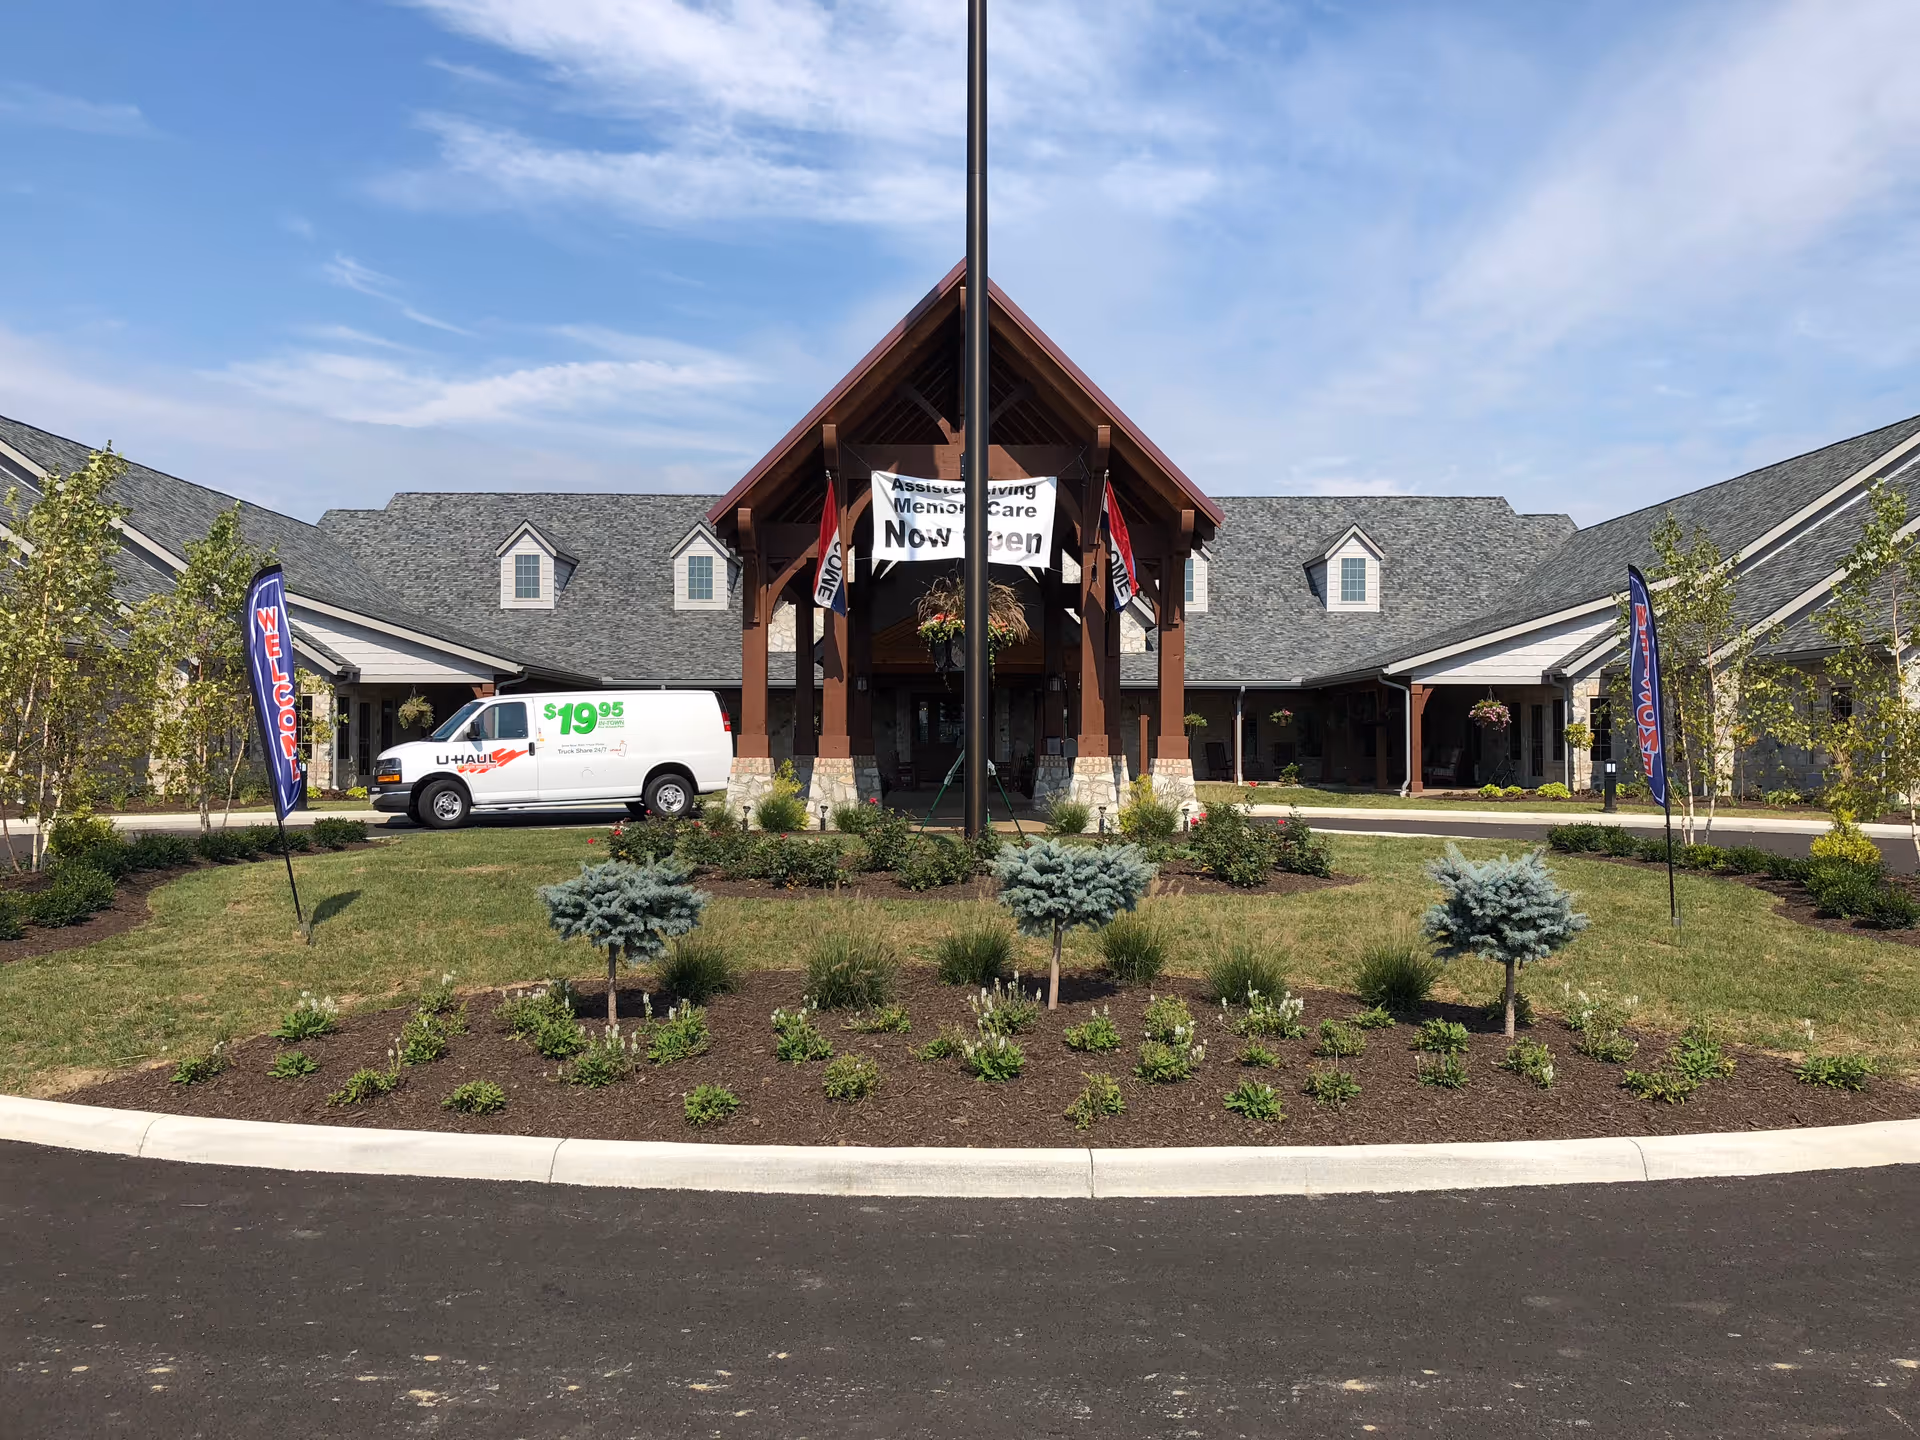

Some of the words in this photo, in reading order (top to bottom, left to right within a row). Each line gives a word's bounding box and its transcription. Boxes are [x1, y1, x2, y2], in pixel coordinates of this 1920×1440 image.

[987, 484, 1037, 500] iving
[893, 497, 966, 514] Memor
[987, 500, 1037, 518] Care
[885, 519, 952, 549] Now
[963, 529, 1042, 556] pen
[256, 605, 302, 782] WELCOME
[436, 753, 497, 765] U-HAUL
